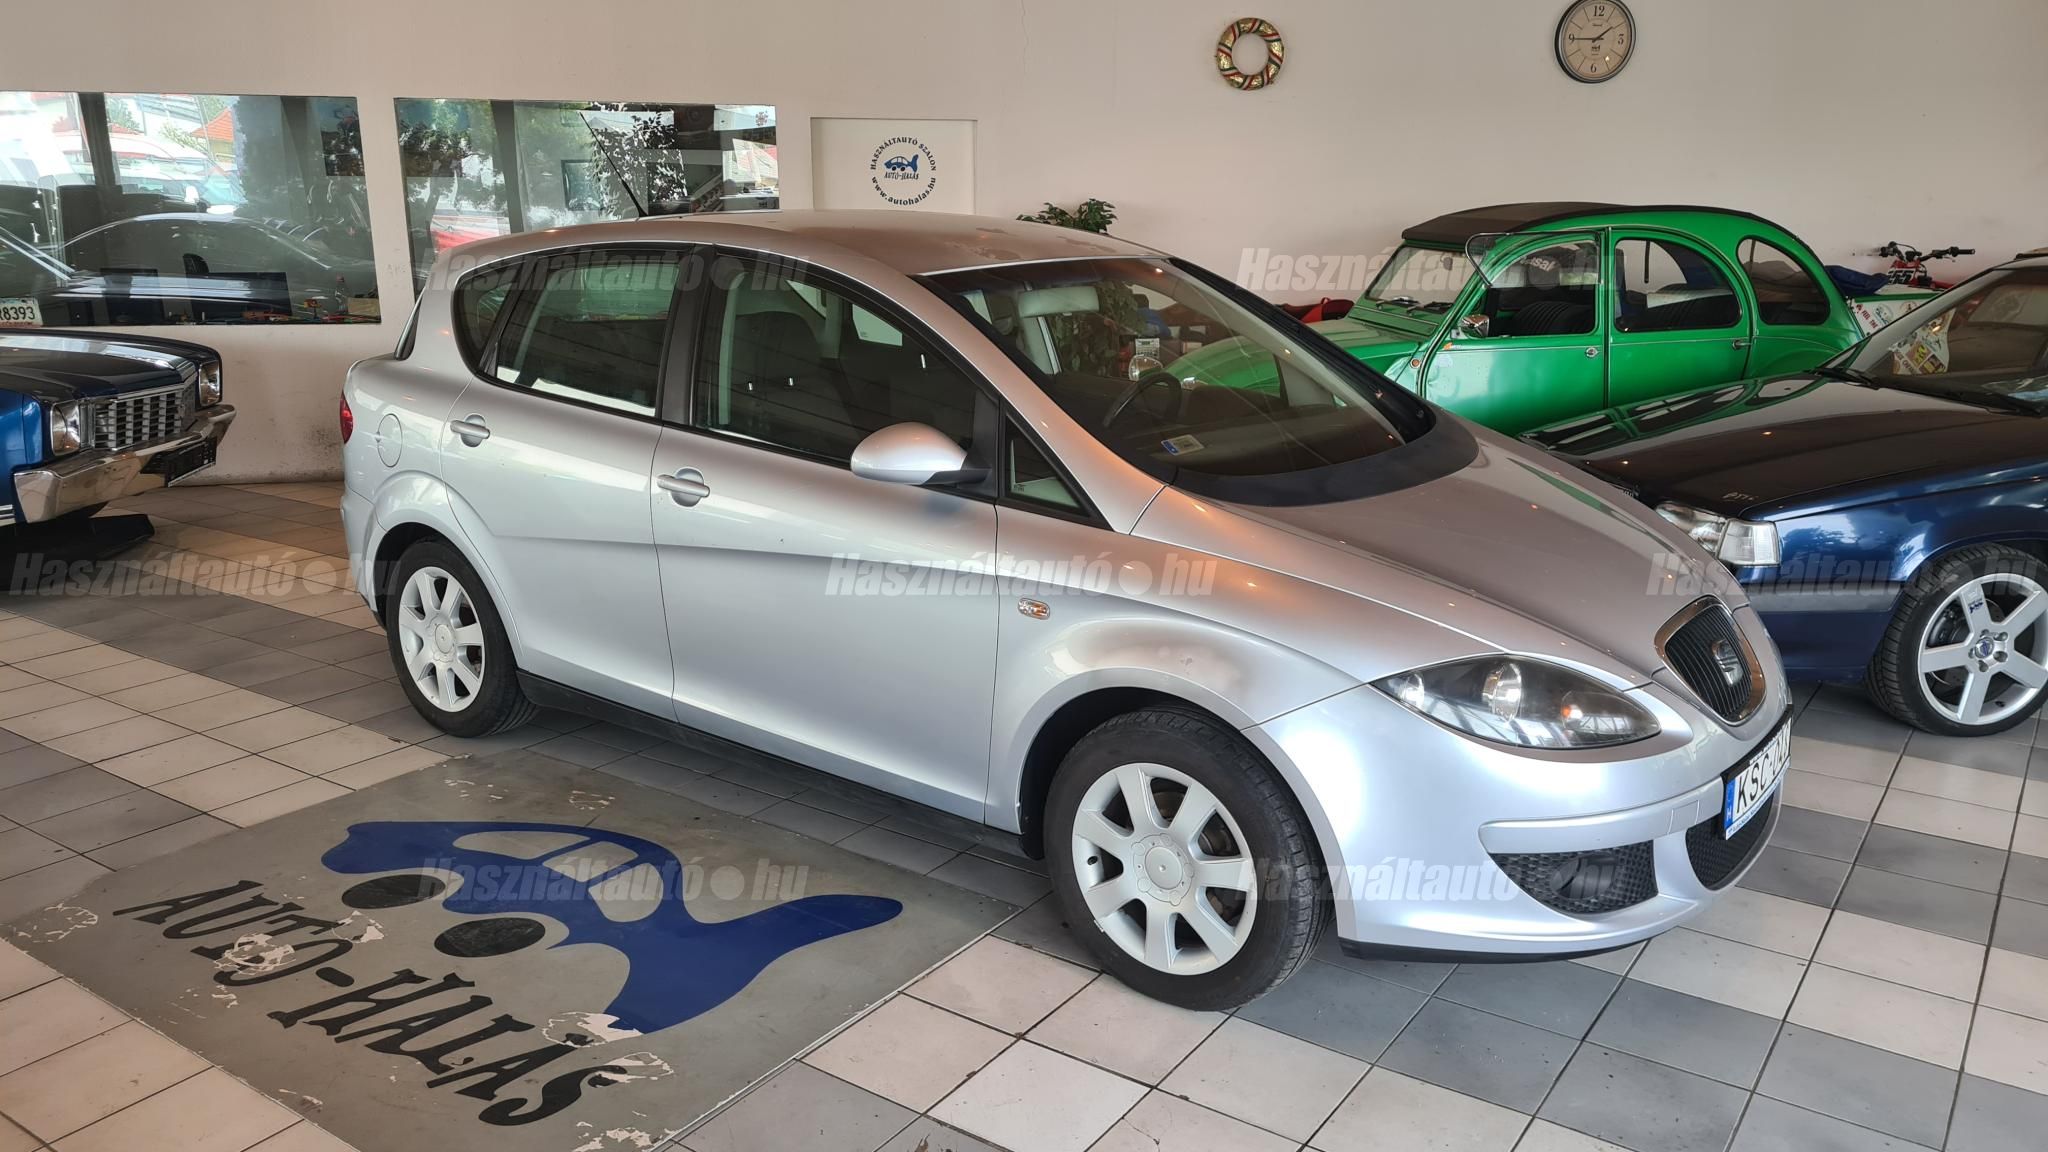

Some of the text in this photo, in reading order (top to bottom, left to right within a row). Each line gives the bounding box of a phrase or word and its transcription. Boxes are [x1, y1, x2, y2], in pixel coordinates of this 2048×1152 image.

[1593, 5, 1605, 17] 12
[1568, 33, 1575, 43] 9
[1617, 33, 1624, 45] 3
[1590, 63, 1597, 73] 6
[919, 143, 937, 171] SZALON
